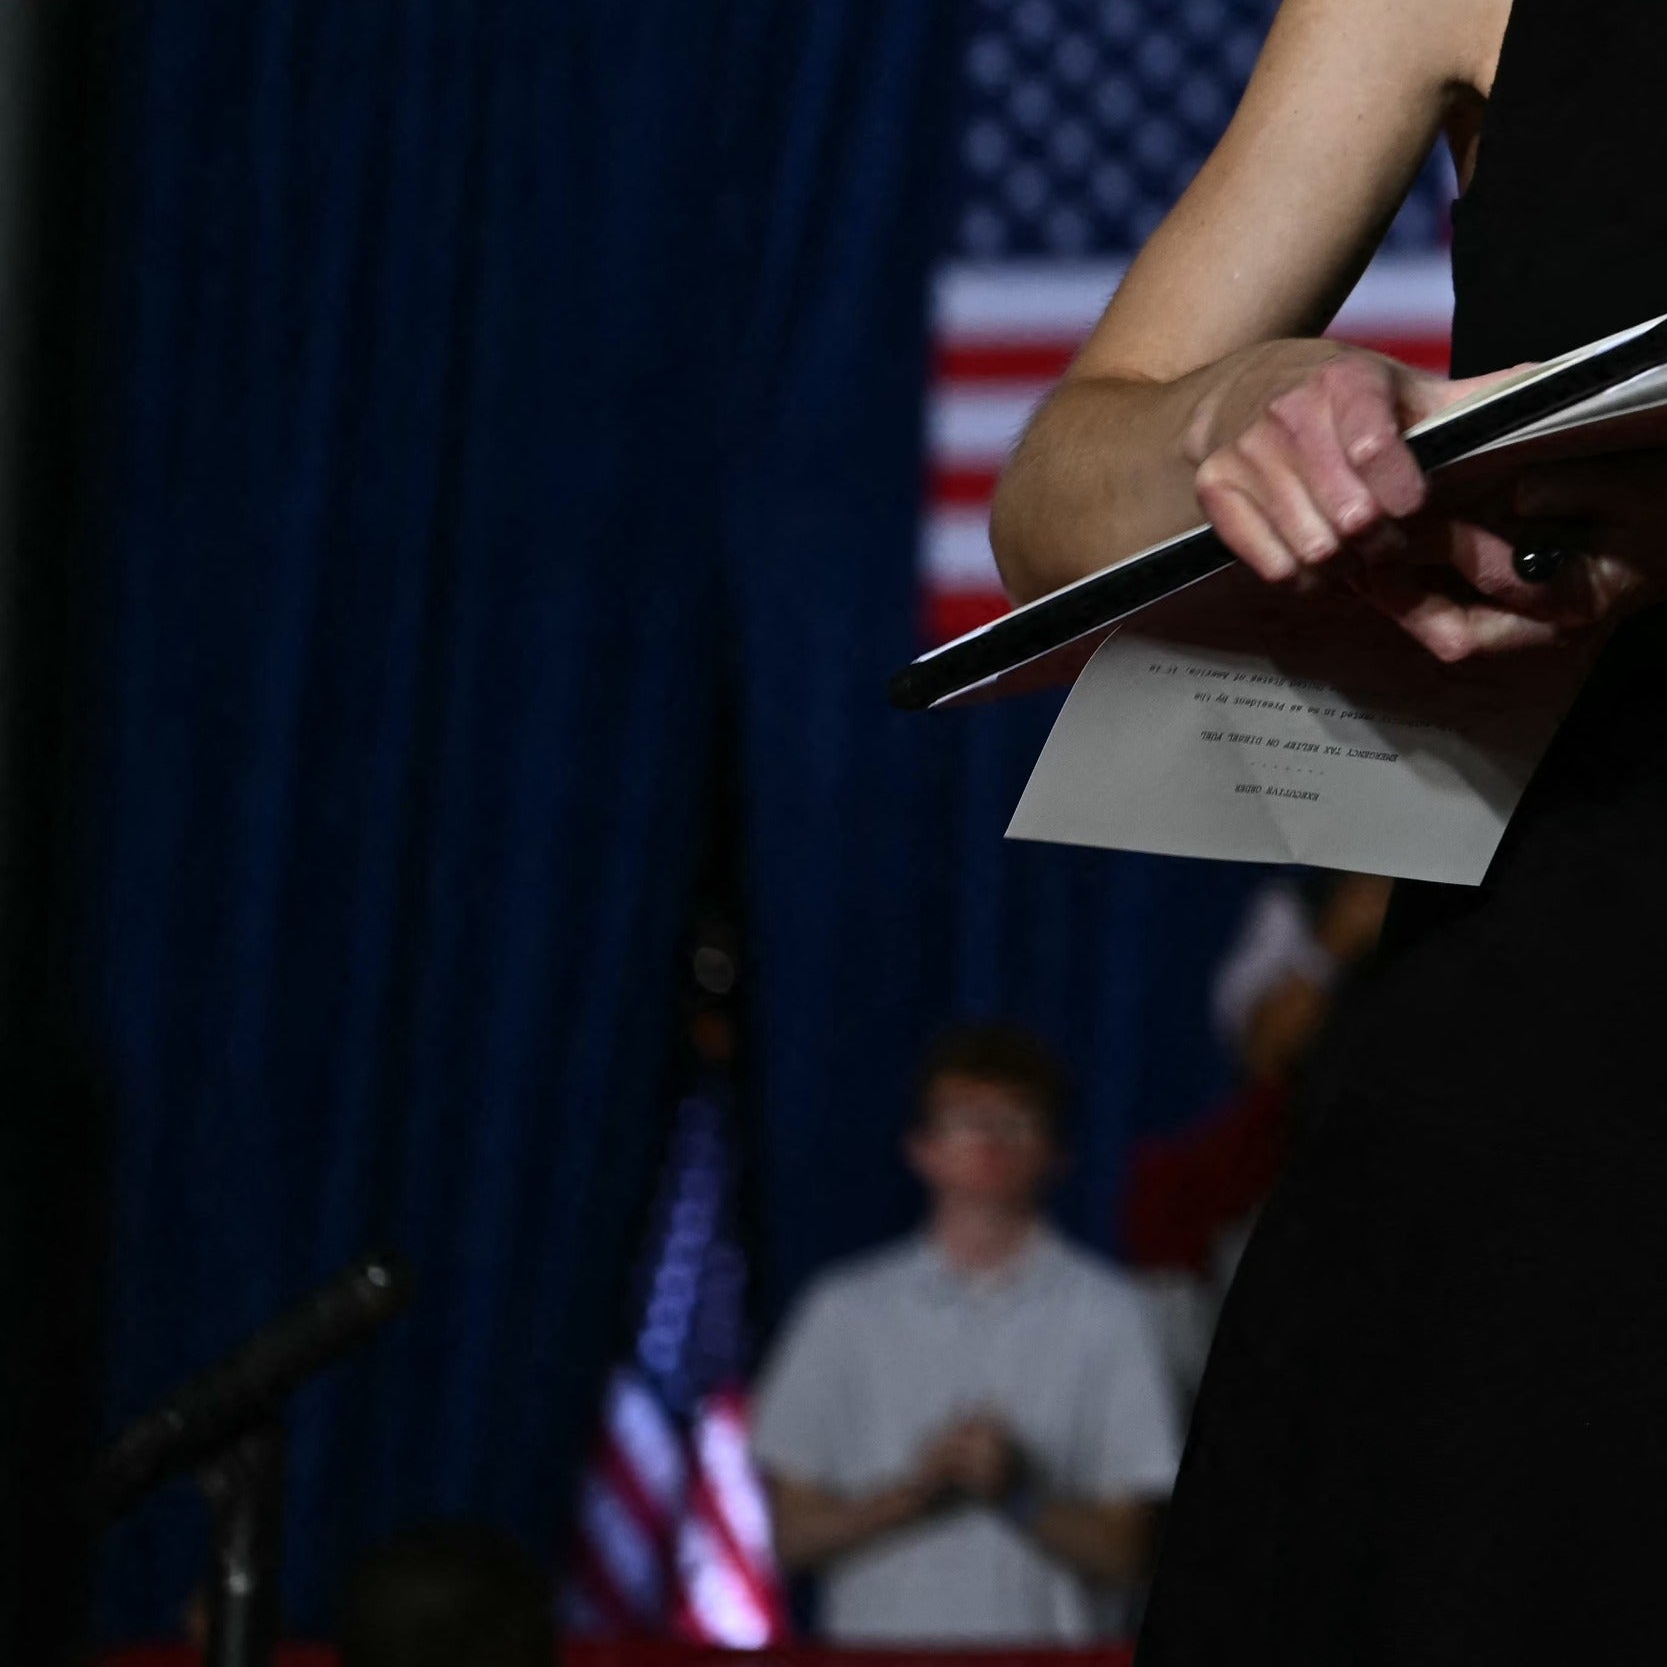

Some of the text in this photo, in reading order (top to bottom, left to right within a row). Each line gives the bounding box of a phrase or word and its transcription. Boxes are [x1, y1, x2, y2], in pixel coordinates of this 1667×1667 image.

[1231, 673, 1246, 682] of
[1193, 693, 1210, 702] the
[1214, 693, 1228, 704] by
[1233, 696, 1284, 712] President
[1289, 704, 1301, 713] as
[1323, 708, 1335, 718] in
[1199, 730, 1397, 761] EMERGENCY TAX RELIEF ON DIESEL FUEL
[1234, 784, 1319, 801] EXECUTIVE ORDER
